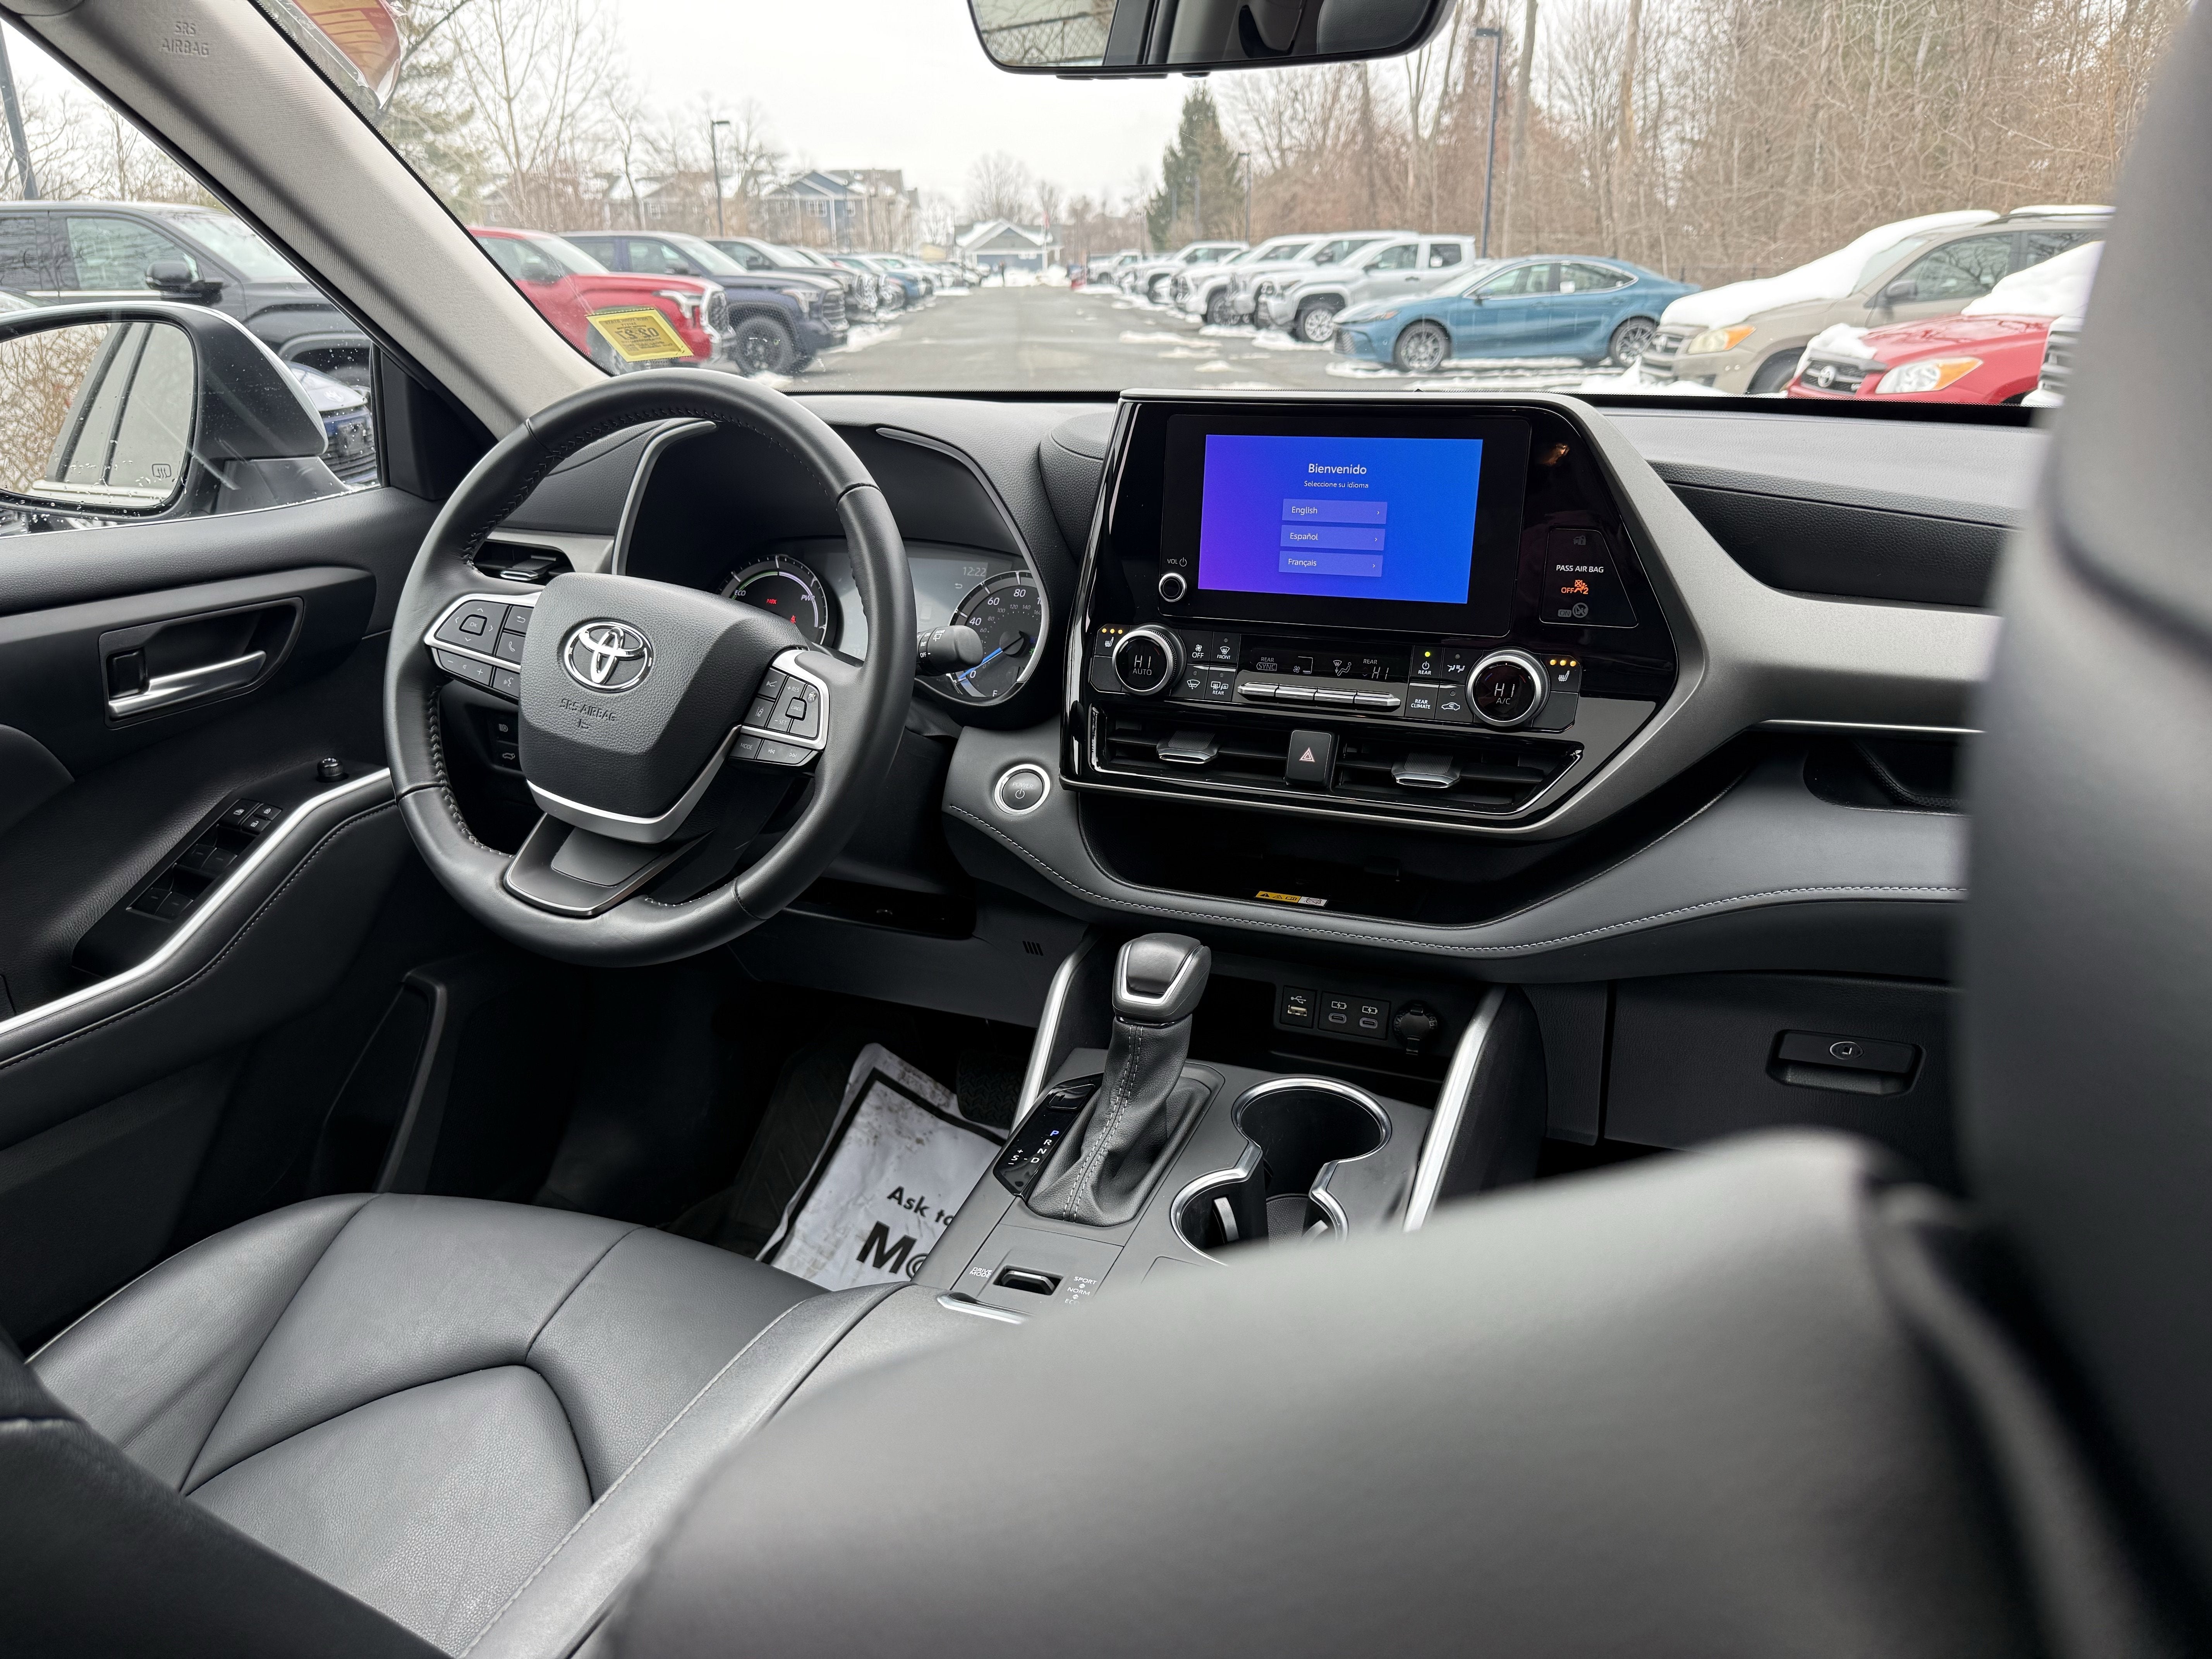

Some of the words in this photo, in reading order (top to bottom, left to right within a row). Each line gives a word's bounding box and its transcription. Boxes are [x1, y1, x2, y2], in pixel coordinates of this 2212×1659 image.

[175, 21, 196, 35] SRS
[161, 38, 210, 56] AIRBAG
[1308, 464, 1367, 474] Bienvenido
[1291, 507, 1317, 515] English
[1288, 558, 1317, 567] Français
[962, 567, 987, 577] 12:22
[1013, 589, 1026, 597] 80
[988, 597, 1000, 605] 60
[969, 617, 982, 626] 40
[970, 670, 976, 678] 0
[560, 698, 579, 711] SRS
[580, 704, 617, 721] AIRBAG
[887, 1185, 930, 1218] Ask
[1073, 1276, 1097, 1285] SPORT
[1067, 1287, 1091, 1296] NORM
